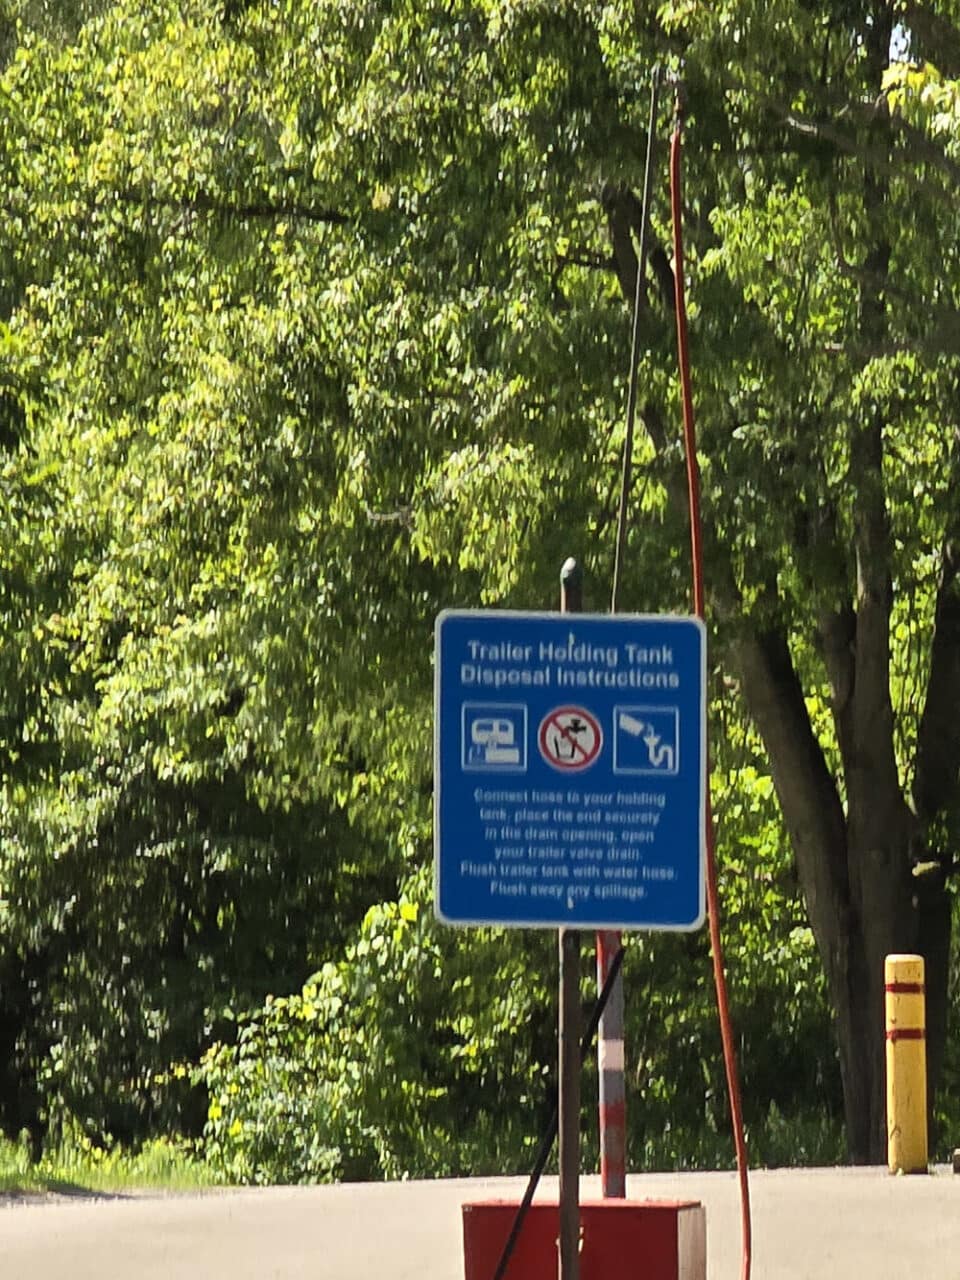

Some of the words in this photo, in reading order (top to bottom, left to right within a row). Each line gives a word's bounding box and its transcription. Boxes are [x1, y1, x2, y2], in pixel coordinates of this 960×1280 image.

[468, 640, 531, 660] Trailer
[539, 641, 618, 665] Holding
[624, 644, 672, 664] Tank
[461, 664, 550, 687] Disposal
[557, 666, 679, 688] Instructions
[532, 790, 562, 803] hose
[567, 791, 579, 803] to
[583, 793, 613, 806] your
[617, 792, 665, 807] holding
[515, 810, 548, 823] place
[553, 810, 573, 821] the
[577, 810, 600, 823] end
[605, 811, 660, 826] securely
[485, 827, 497, 839] in
[501, 828, 520, 840] the
[525, 828, 558, 841] drain
[622, 831, 655, 843] open
[495, 847, 524, 859] your
[528, 846, 565, 858] trailer
[570, 847, 603, 859] valve
[461, 861, 496, 876] Flush
[501, 863, 538, 876] trailer
[542, 864, 568, 877] tank
[573, 865, 600, 878] with
[604, 865, 638, 878] water
[490, 881, 527, 895] Flush
[530, 883, 564, 897] away
[567, 884, 590, 897] any
